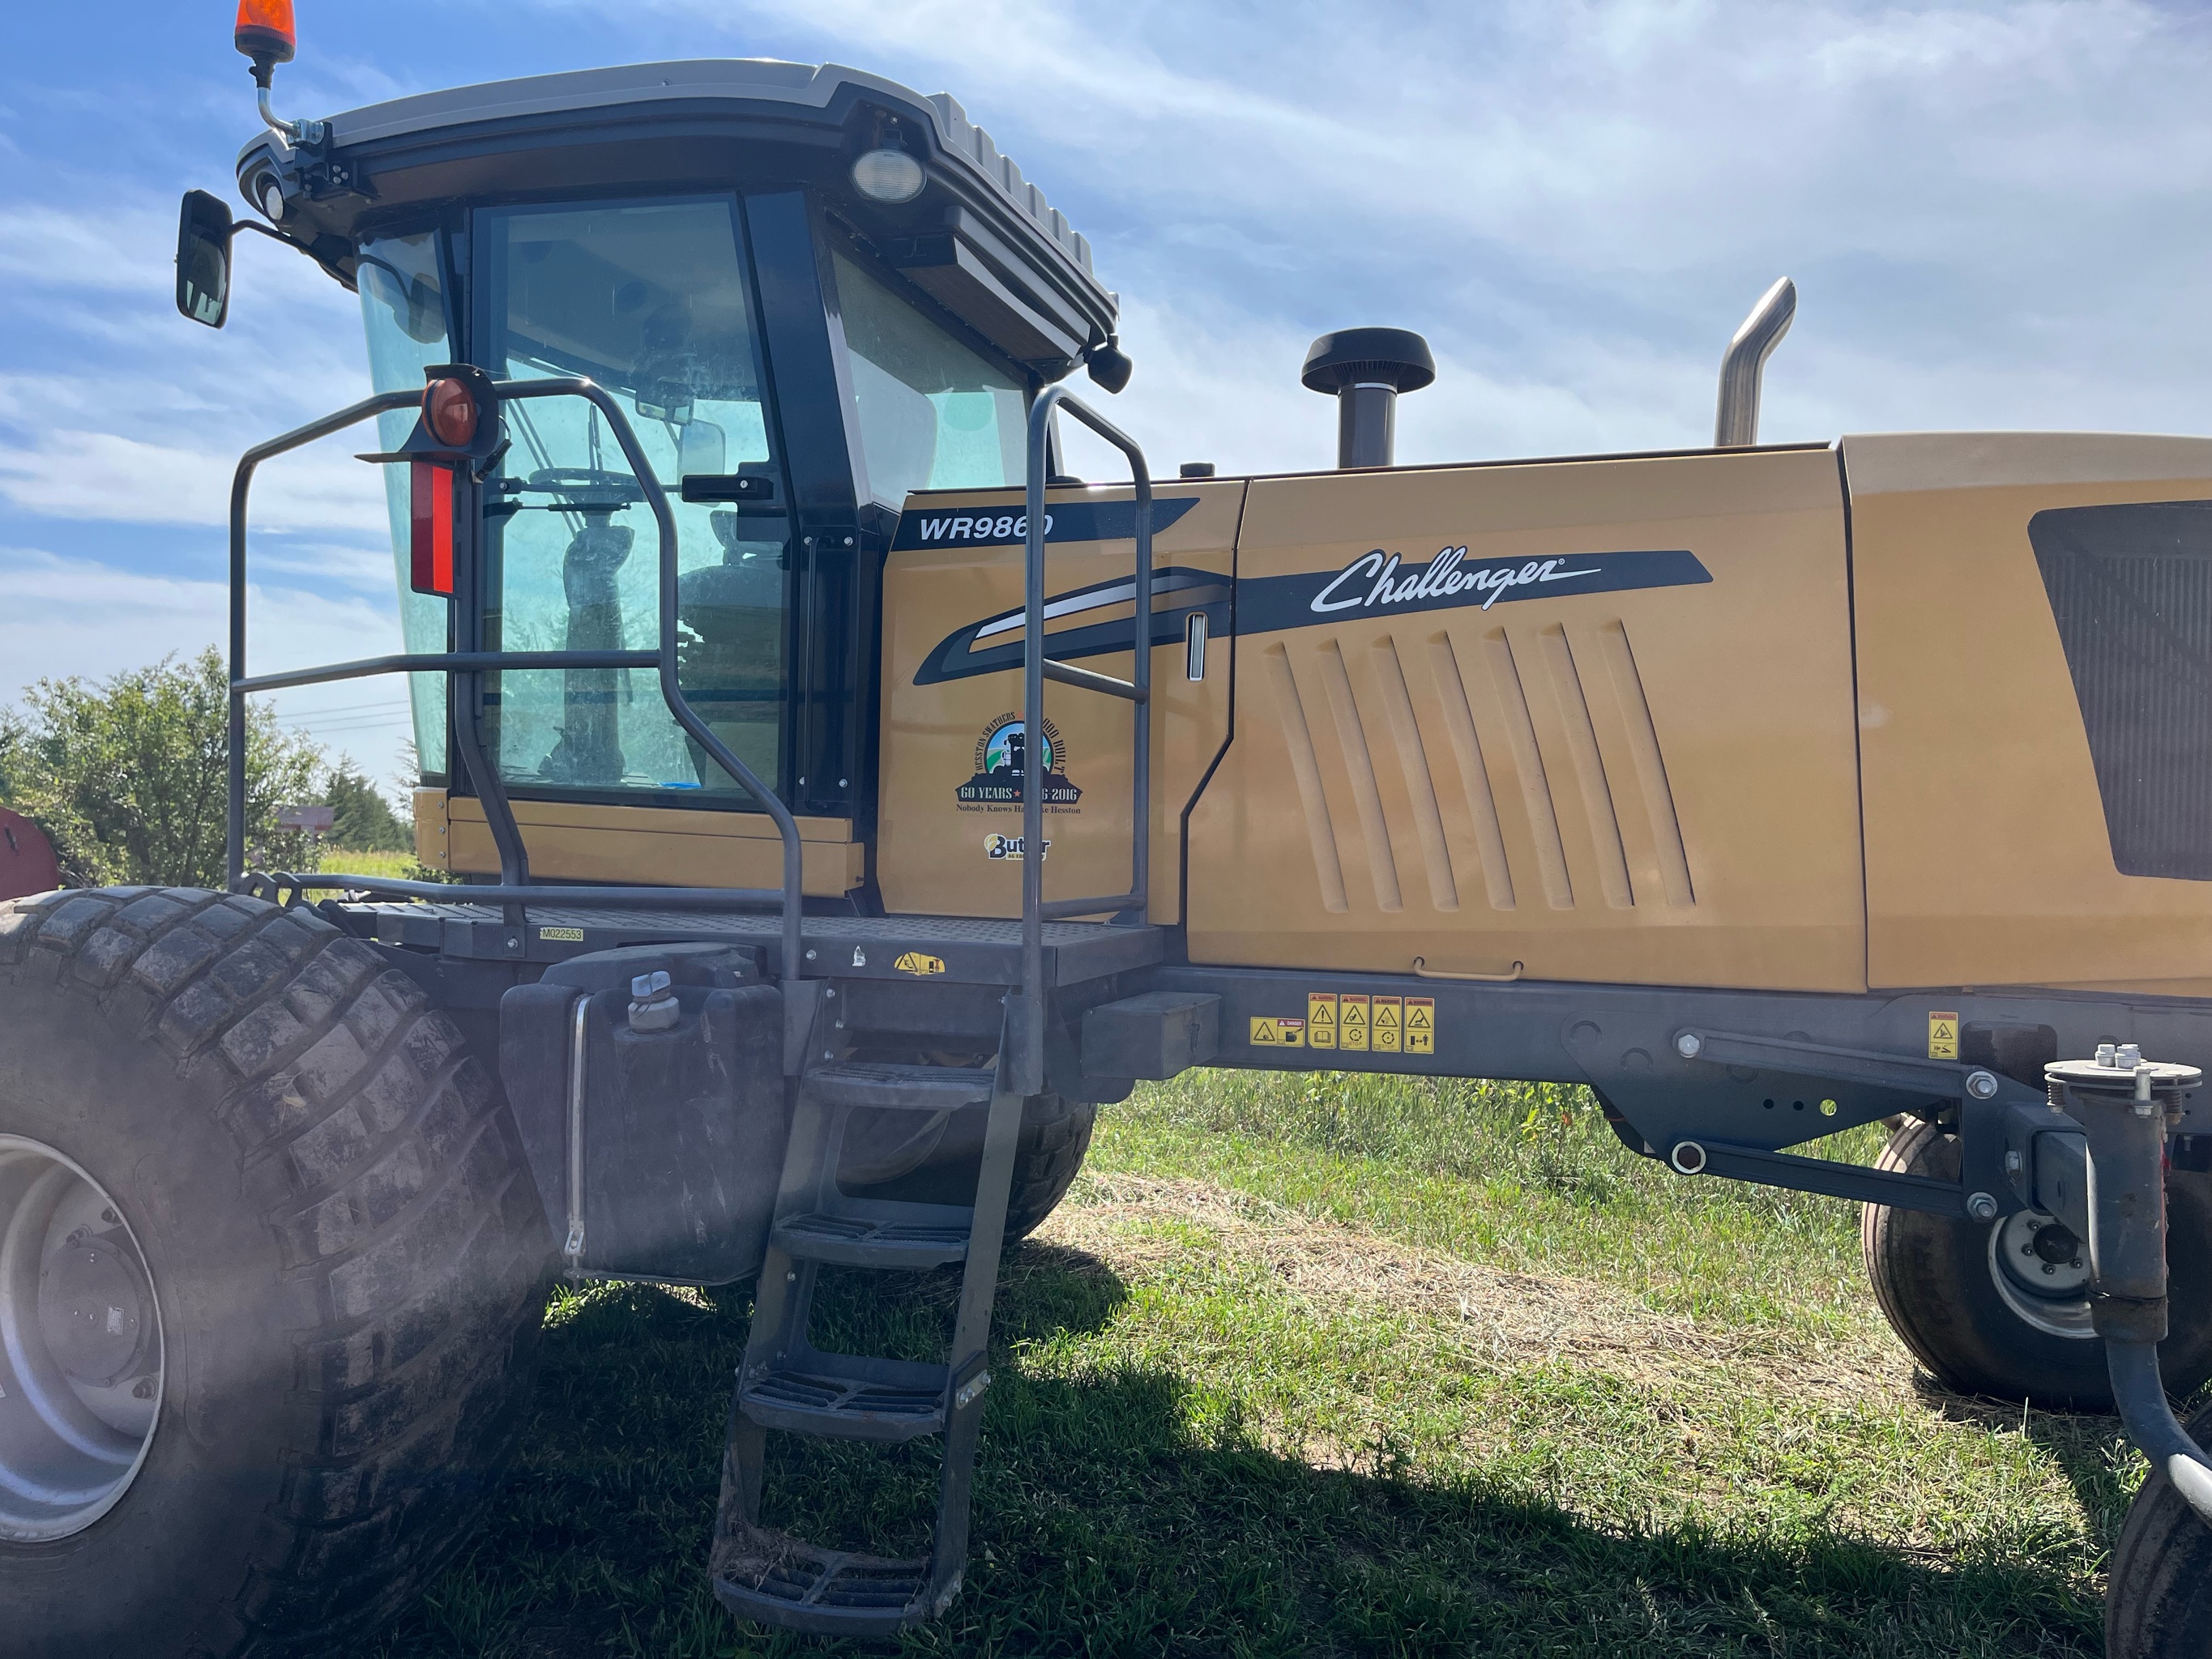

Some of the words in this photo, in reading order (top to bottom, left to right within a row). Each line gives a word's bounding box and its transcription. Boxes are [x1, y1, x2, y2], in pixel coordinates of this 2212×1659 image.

[975, 736, 987, 771] HESSTON
[982, 711, 1016, 738] SWATHERS
[1053, 739, 1066, 774] BUILT
[961, 787, 975, 799] 60
[979, 787, 1013, 800] YEARS
[956, 804, 984, 814] Nobody
[987, 804, 1012, 812] Knows
[1051, 806, 1081, 815] Hesston
[989, 835, 1050, 859] Butr
[543, 928, 582, 940] M022553
